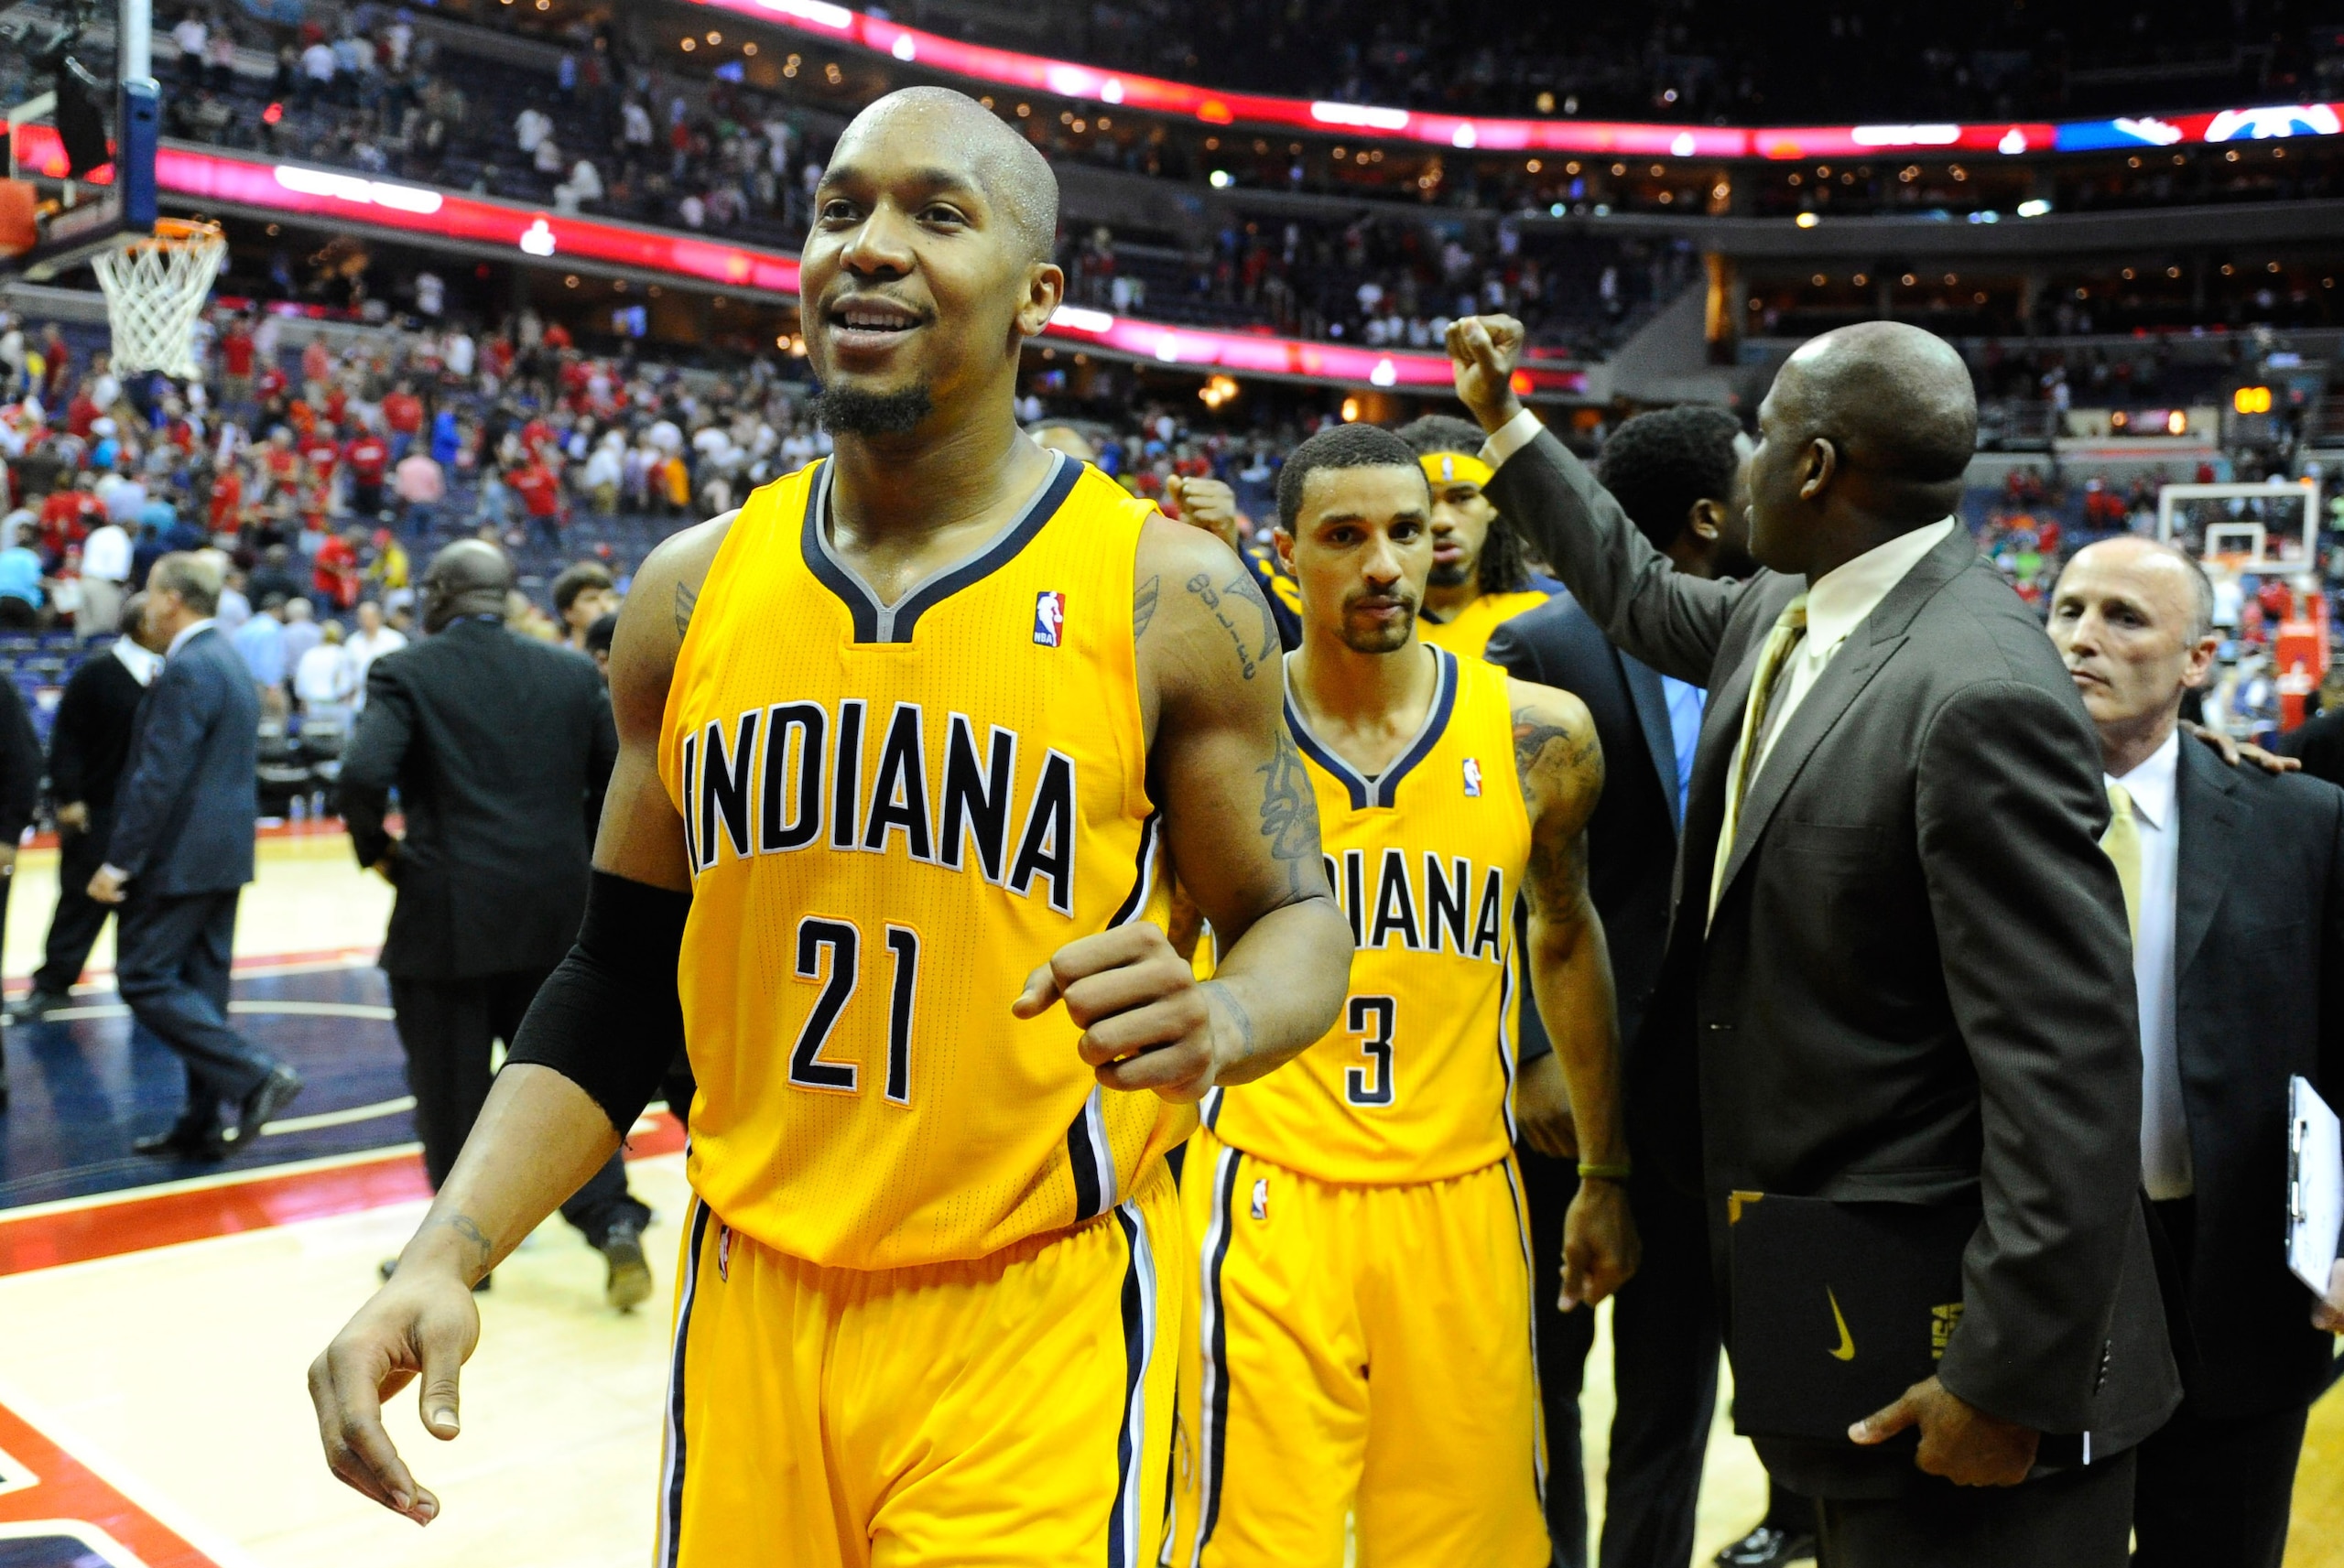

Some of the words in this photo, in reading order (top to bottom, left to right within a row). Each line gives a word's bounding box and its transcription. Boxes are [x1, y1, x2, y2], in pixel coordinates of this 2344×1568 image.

[1034, 632, 1053, 644] NBA
[682, 698, 1075, 919] INDIANA
[788, 915, 920, 1106] 21
[1345, 994, 1397, 1107] 3
